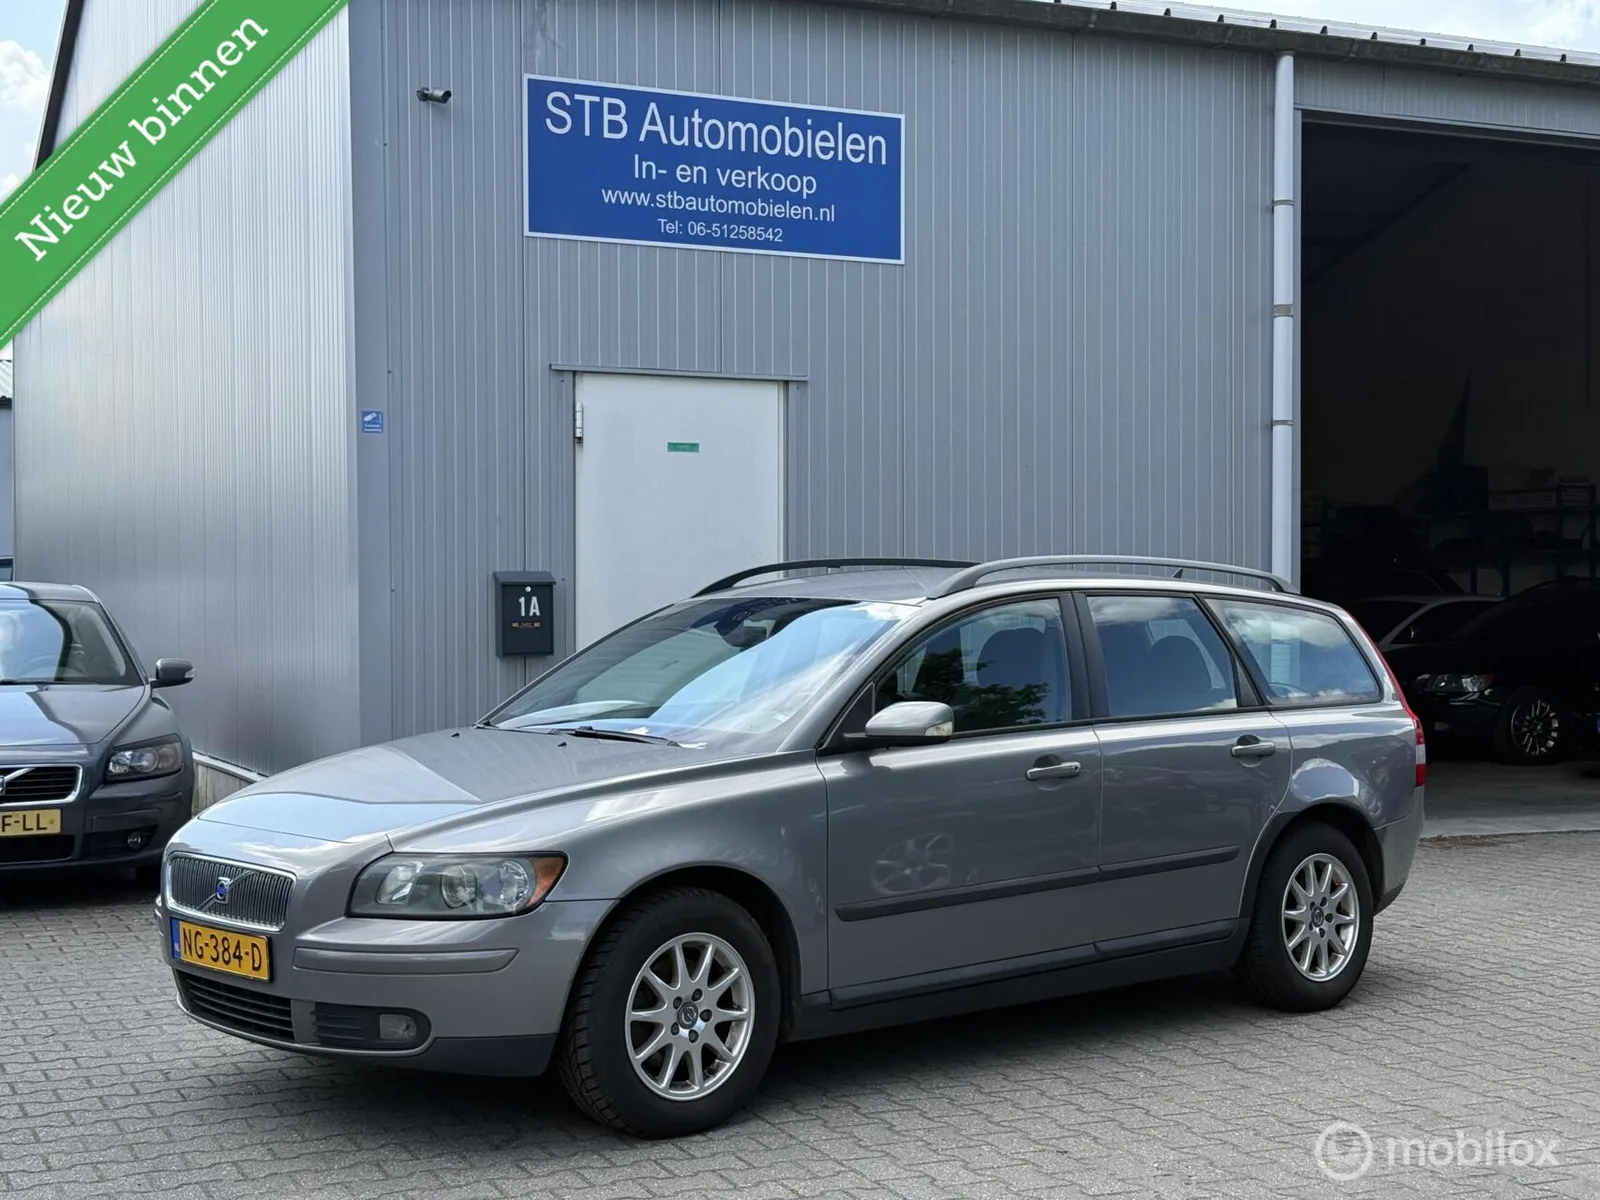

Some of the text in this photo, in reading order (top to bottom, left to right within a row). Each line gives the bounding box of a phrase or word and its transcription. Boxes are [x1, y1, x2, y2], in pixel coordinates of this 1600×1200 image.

[545, 91, 888, 165] STB Automobielen
[633, 154, 818, 199] In- en verkoop
[601, 188, 836, 223] www.stbautomobielen.nl
[657, 218, 783, 243] Tel: 06-51258542
[518, 596, 540, 617] 1A
[182, 927, 262, 972] NG-384-D
